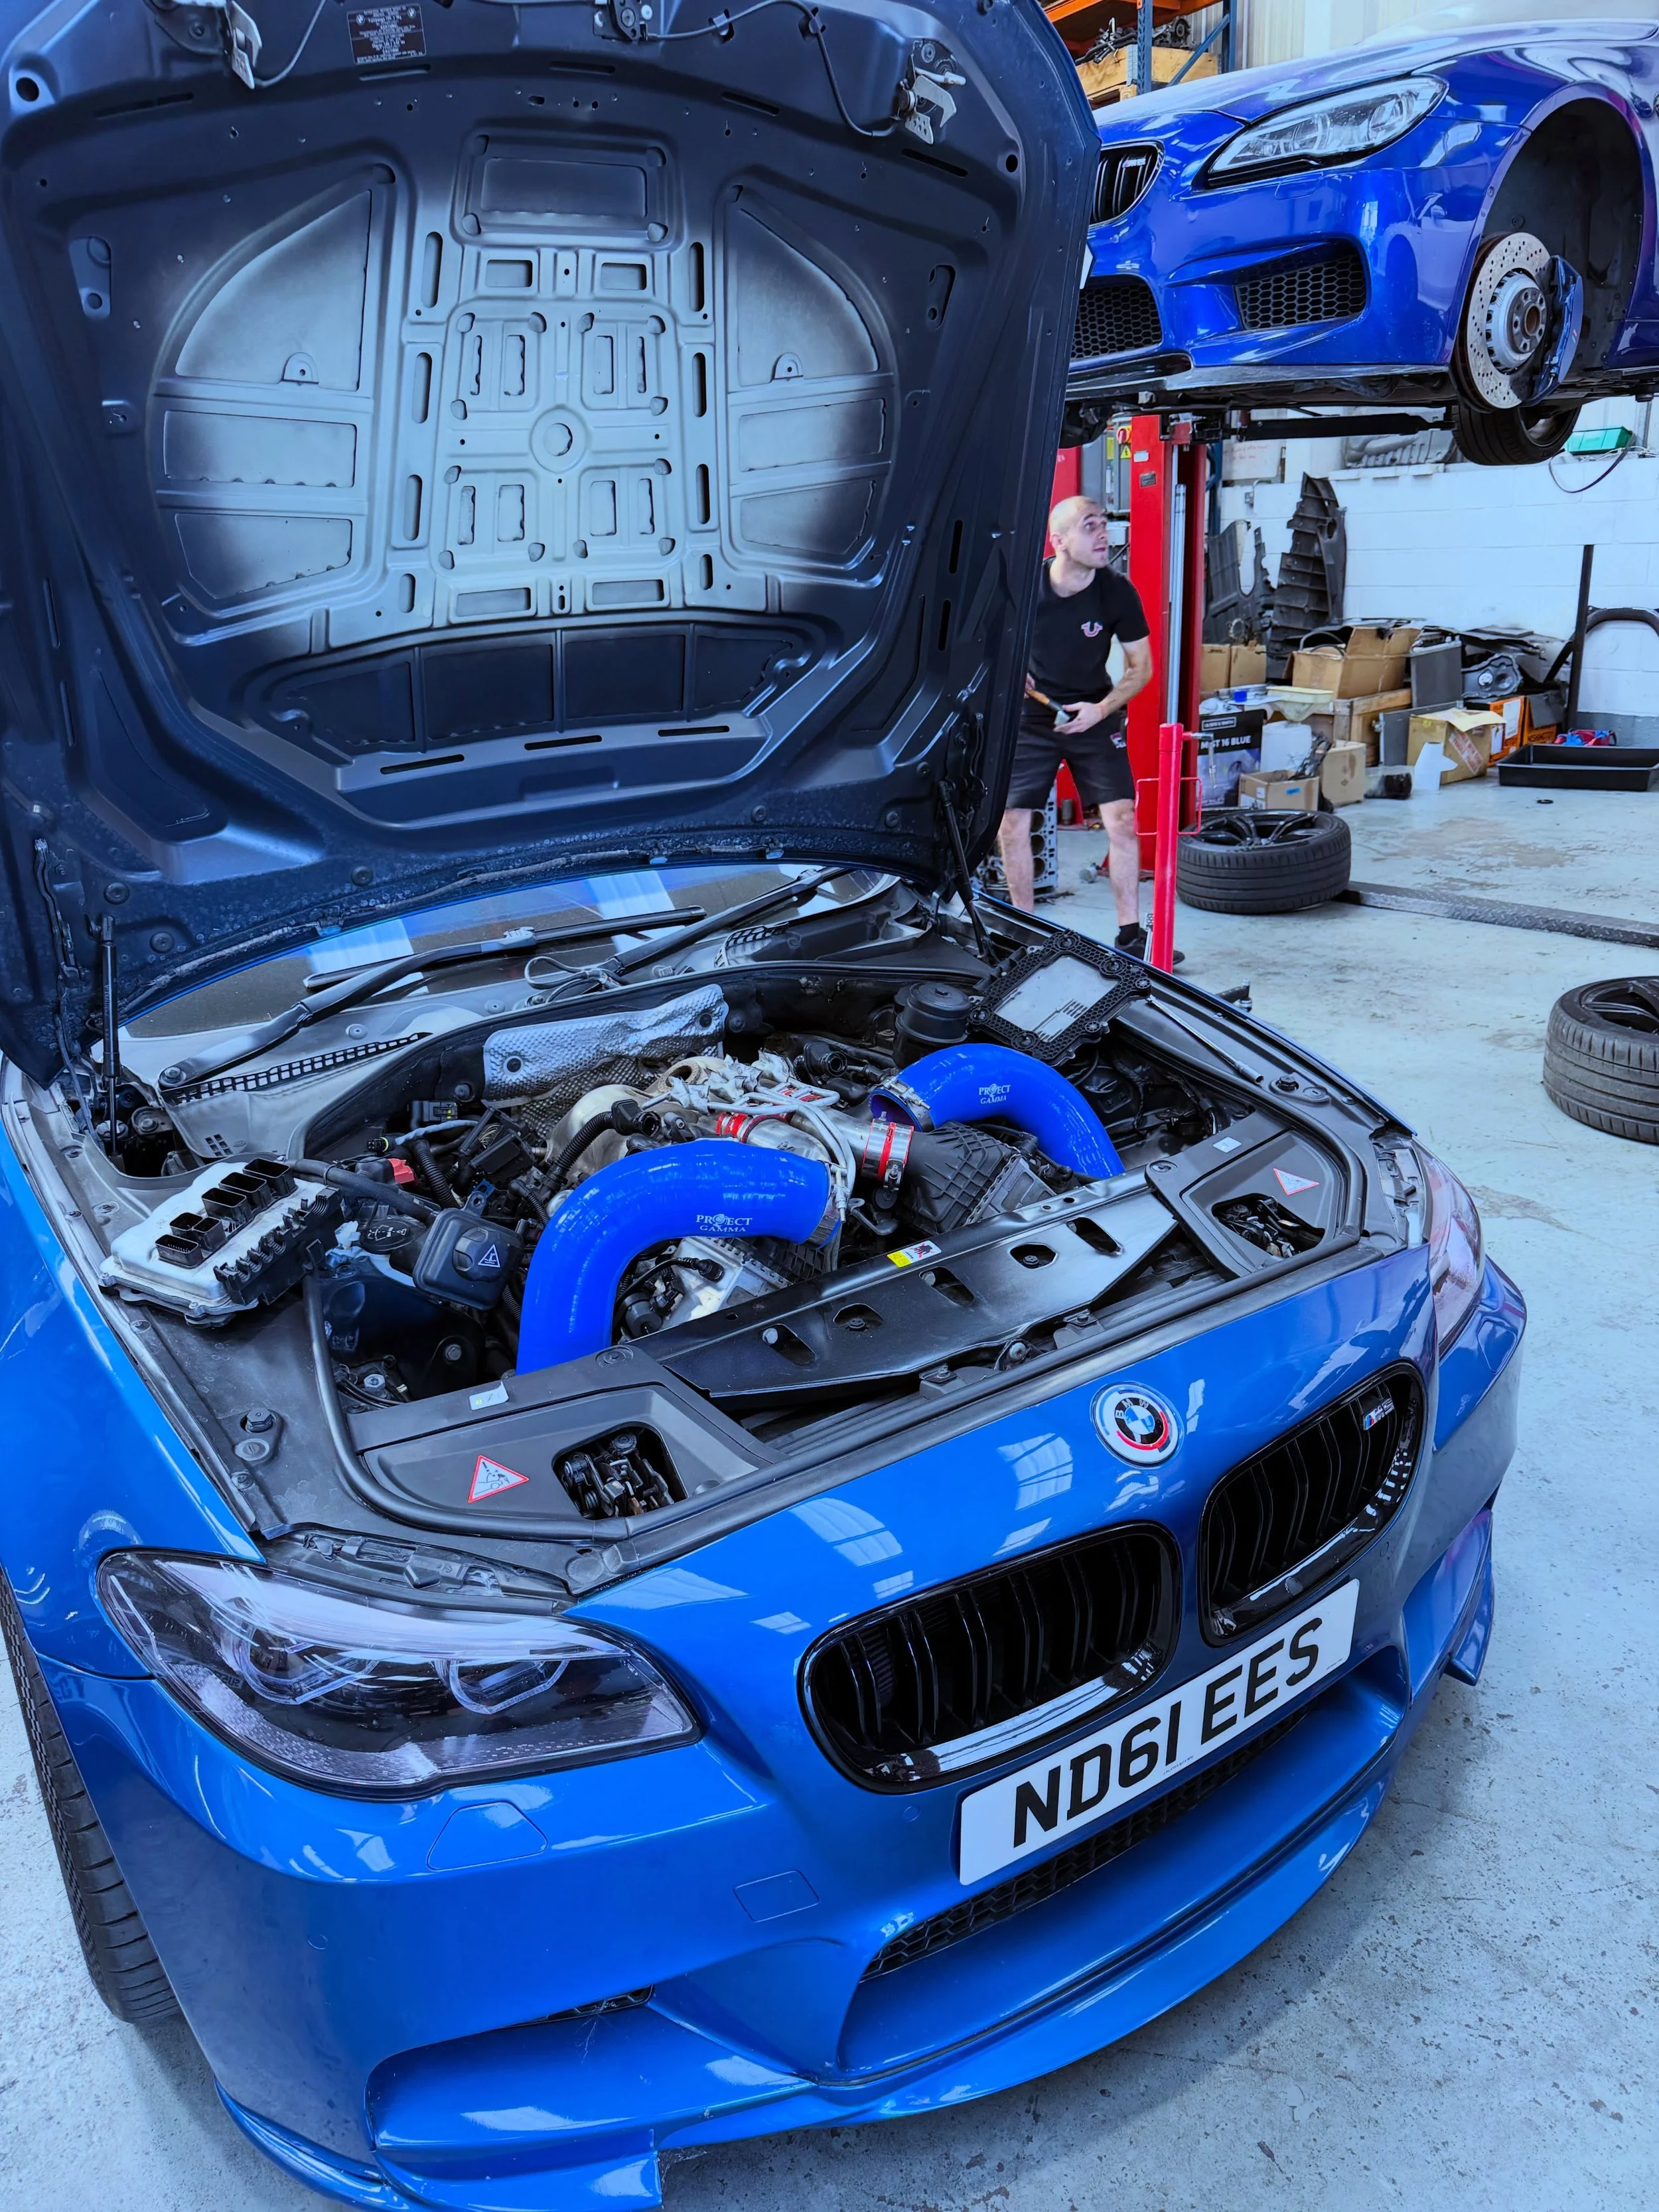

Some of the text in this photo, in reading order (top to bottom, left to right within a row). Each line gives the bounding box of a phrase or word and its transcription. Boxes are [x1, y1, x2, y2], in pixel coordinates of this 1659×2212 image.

[1222, 738, 1230, 747] 16
[1231, 735, 1251, 745] BLUE
[980, 1095, 1006, 1104] GAMMA
[1115, 1398, 1149, 1420] BMW
[1201, 1617, 1323, 1745] EES
